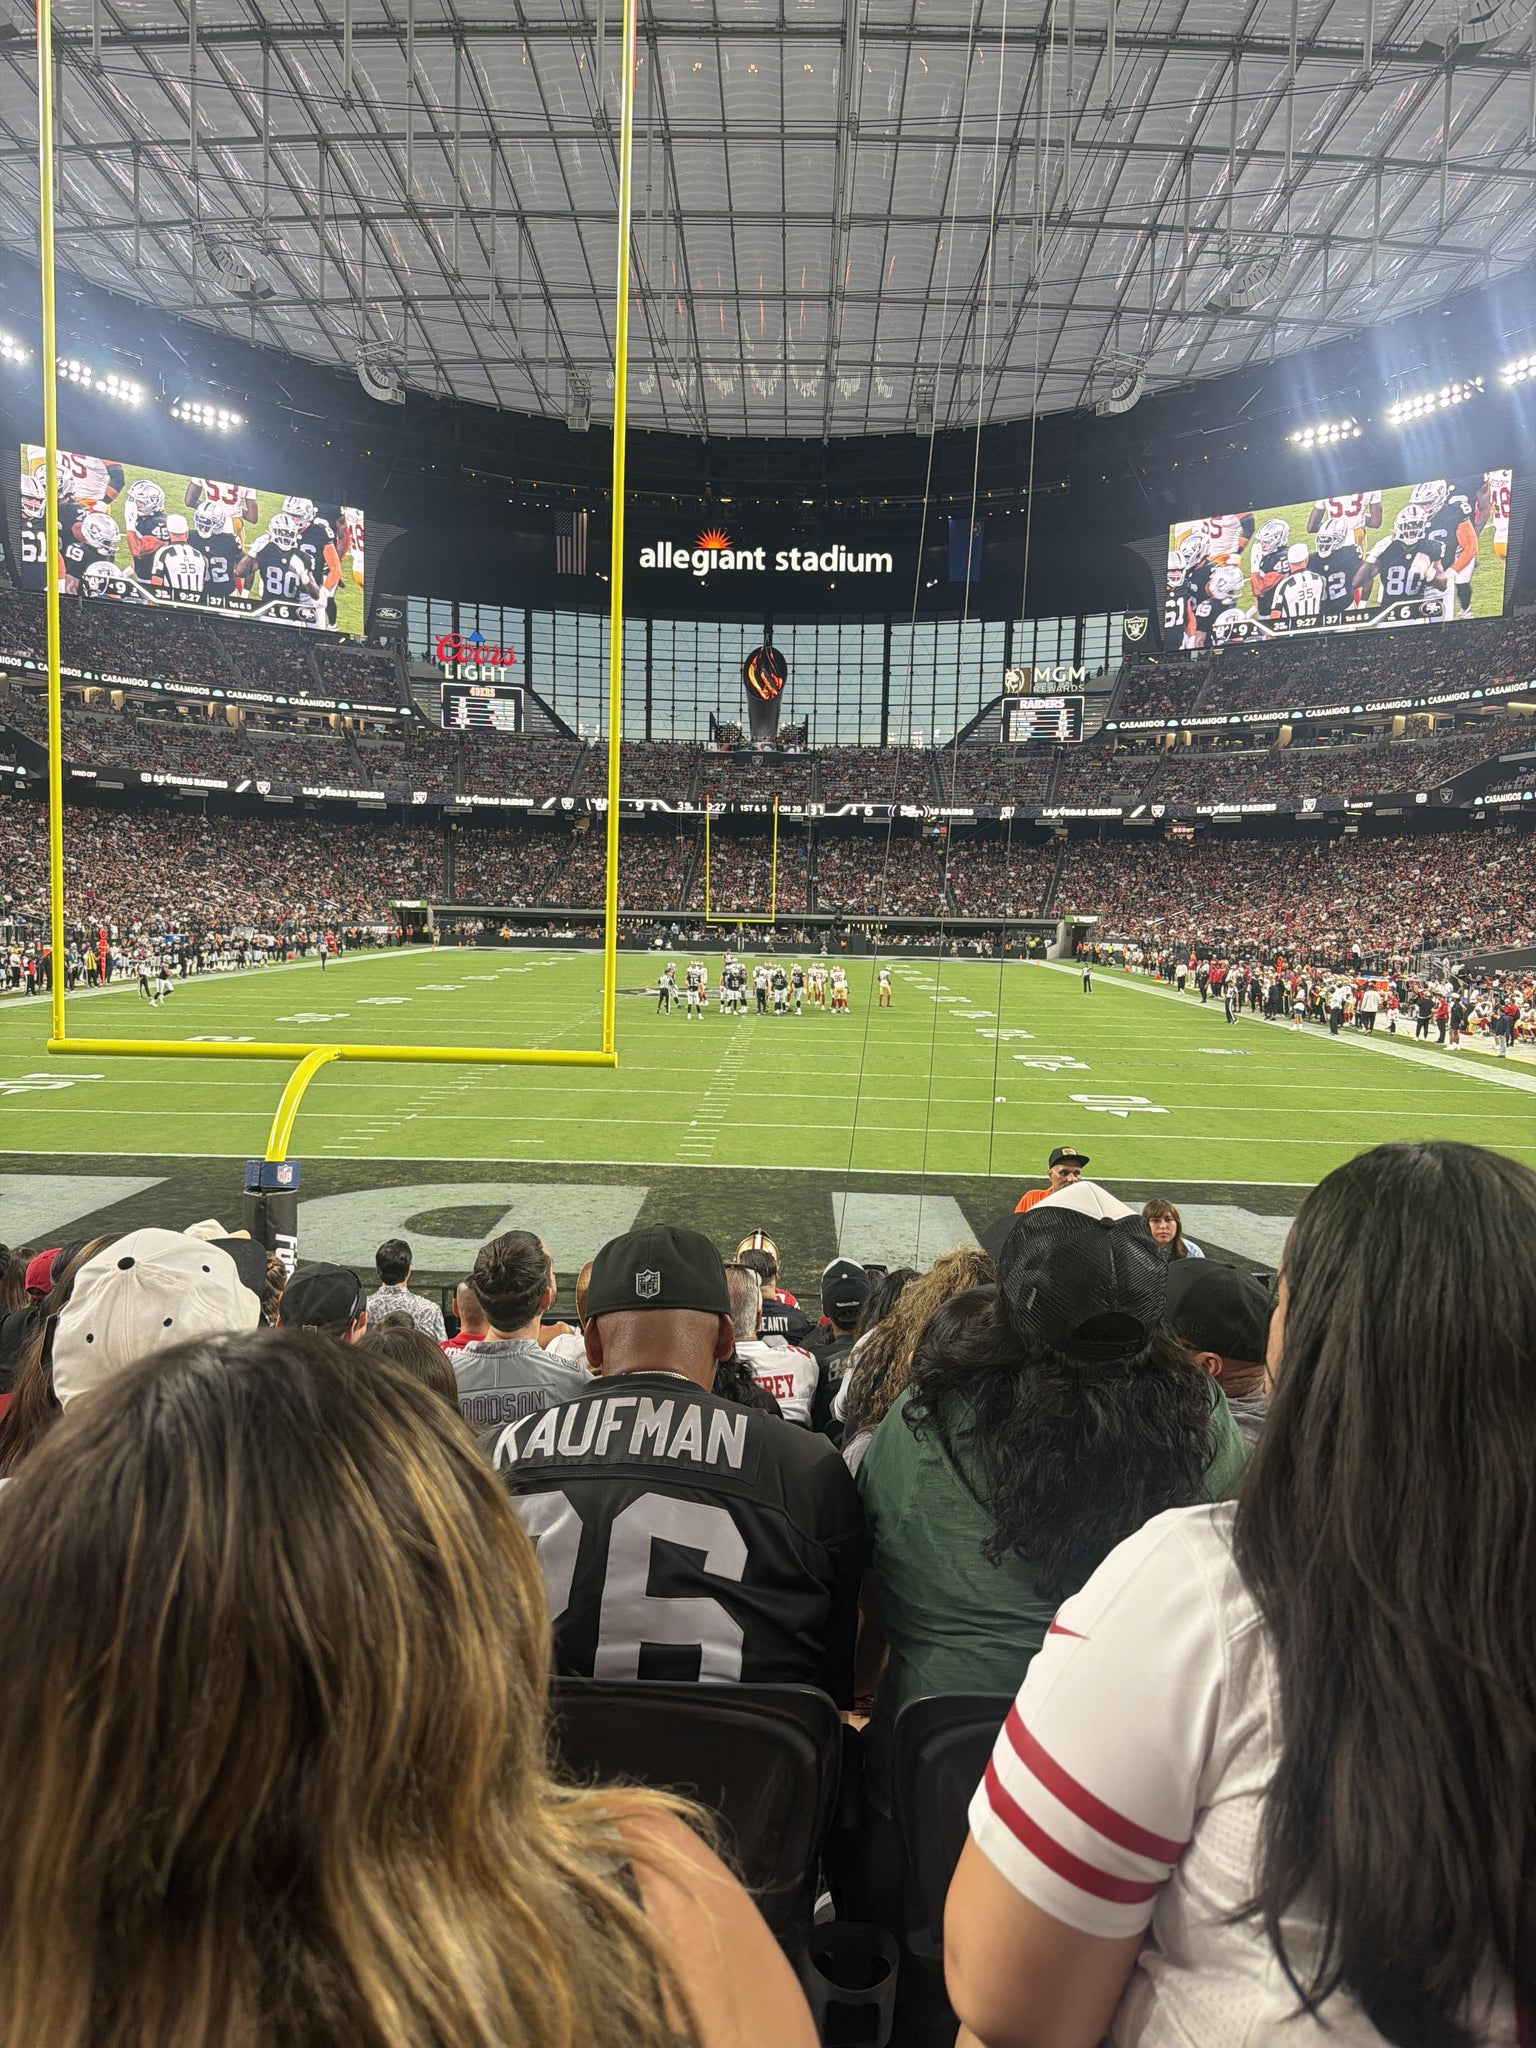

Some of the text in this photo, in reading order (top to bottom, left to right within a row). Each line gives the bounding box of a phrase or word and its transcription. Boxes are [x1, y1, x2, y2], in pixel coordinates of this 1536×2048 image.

[639, 541, 892, 576] allegiant stadium
[180, 563, 196, 574] 35
[266, 566, 300, 598] 80
[1386, 566, 1424, 596] 80
[116, 582, 126, 594] 9
[180, 592, 200, 603] 9:27
[1298, 588, 1314, 601] 35
[210, 596, 222, 606] 37
[280, 606, 289, 617] 6
[1401, 606, 1410, 618] 6
[1296, 618, 1317, 627] 9:27
[1326, 616, 1338, 625] 37
[1238, 625, 1248, 635] 9
[435, 633, 517, 666] Coors
[445, 664, 507, 682] LIGHT
[1034, 666, 1085, 682] MGM
[101, 673, 148, 688] CASAMIGOS
[164, 682, 210, 696] CASAMIGOS
[1033, 684, 1085, 693] REWARDS
[1485, 682, 1528, 696] CASAMIGOS
[226, 690, 273, 702] CASAMIGOS
[1428, 691, 1470, 705] CASAMIGOS
[288, 697, 336, 709] CASAMIGOS
[1020, 699, 1065, 709] RAIDERS
[1366, 700, 1412, 711] CASAMIGOS
[1243, 712, 1289, 722] CASAMIGOS
[1305, 706, 1350, 718] CASAMIGOS
[1119, 720, 1165, 729] CASAMIGOS
[1181, 716, 1228, 726] CASAMIGOS
[302, 786, 385, 799] LAS VEGAS RAIDERS
[1485, 793, 1522, 804] CASAMIGOS
[455, 795, 534, 806] LAS VEGAS RAIDERS
[740, 804, 753, 812] 1ST
[940, 808, 974, 816] RAIDERS
[1042, 806, 1122, 818] LAS VEGAS RAIDERS
[1196, 803, 1277, 816] LAS VEGAS RAIDERS
[690, 977, 698, 986] 15
[492, 1396, 748, 1470] KAUFMAN
